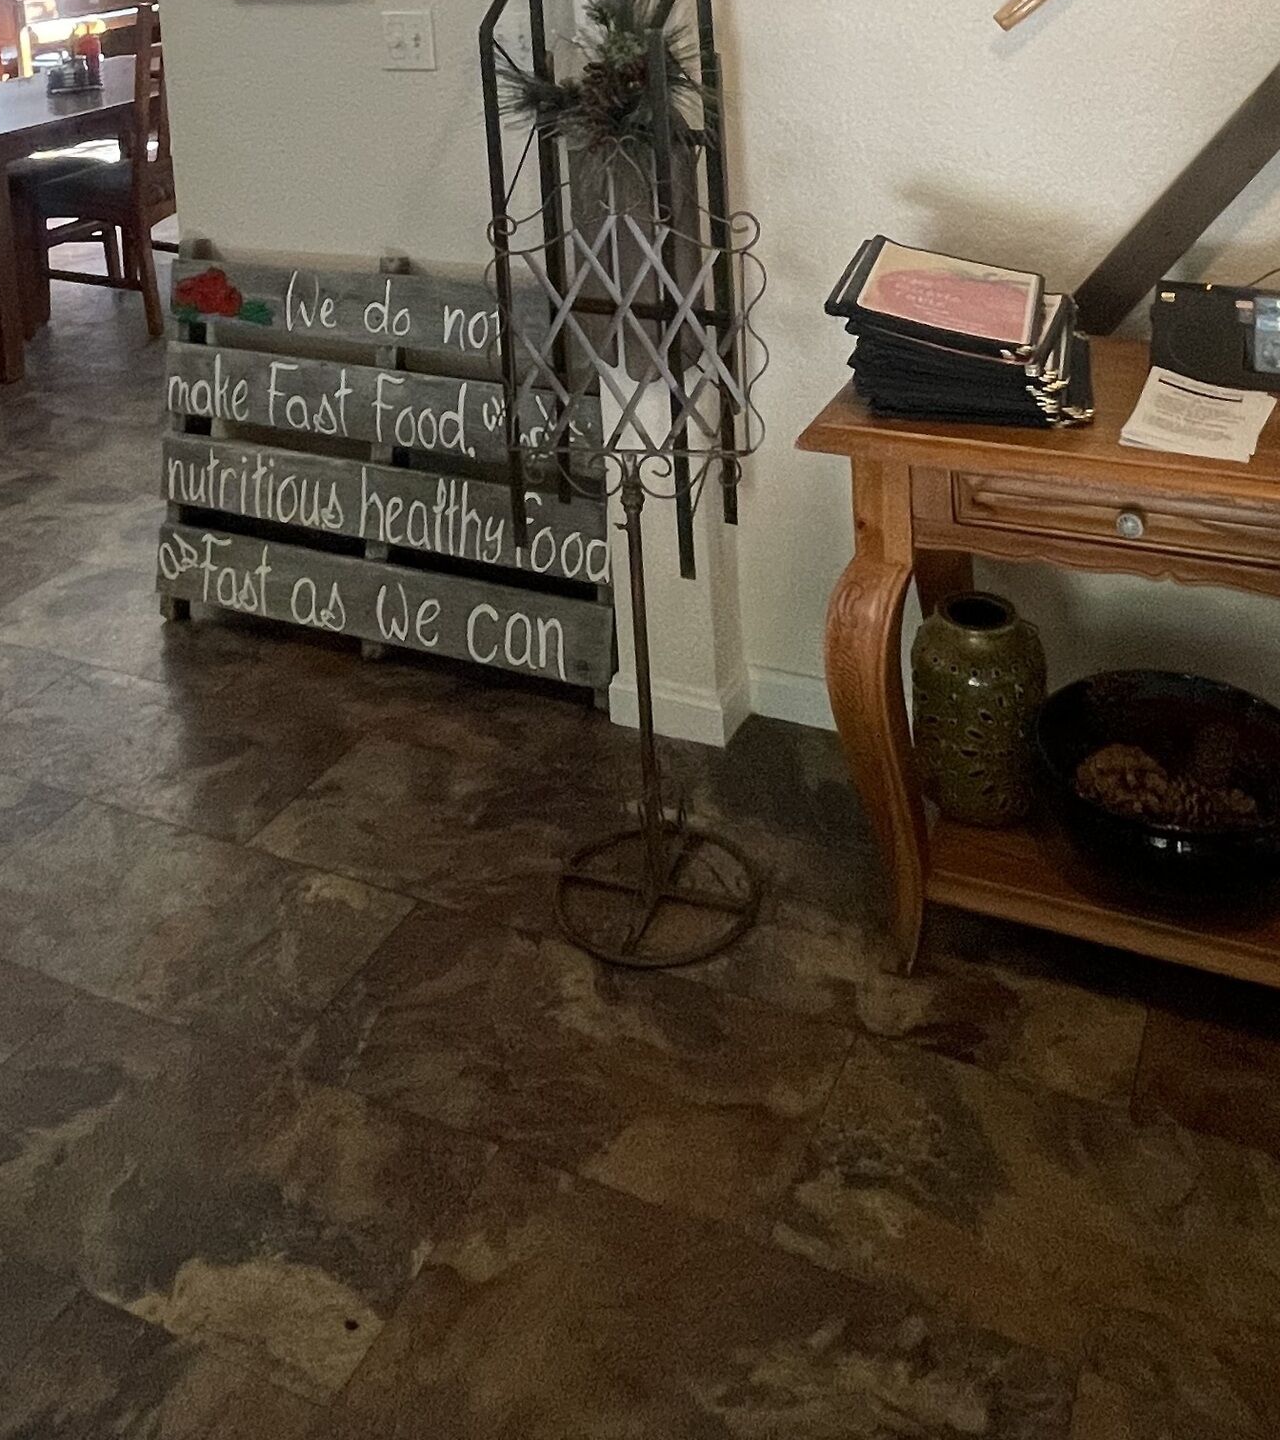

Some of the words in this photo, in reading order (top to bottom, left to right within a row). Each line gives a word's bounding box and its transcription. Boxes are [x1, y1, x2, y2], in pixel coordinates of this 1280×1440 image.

[364, 279, 411, 336] do
[168, 353, 249, 422] make
[267, 361, 354, 438] Fast
[168, 447, 344, 529] nutritious
[159, 532, 199, 580] as
[290, 577, 346, 632] as
[466, 603, 568, 681] can
